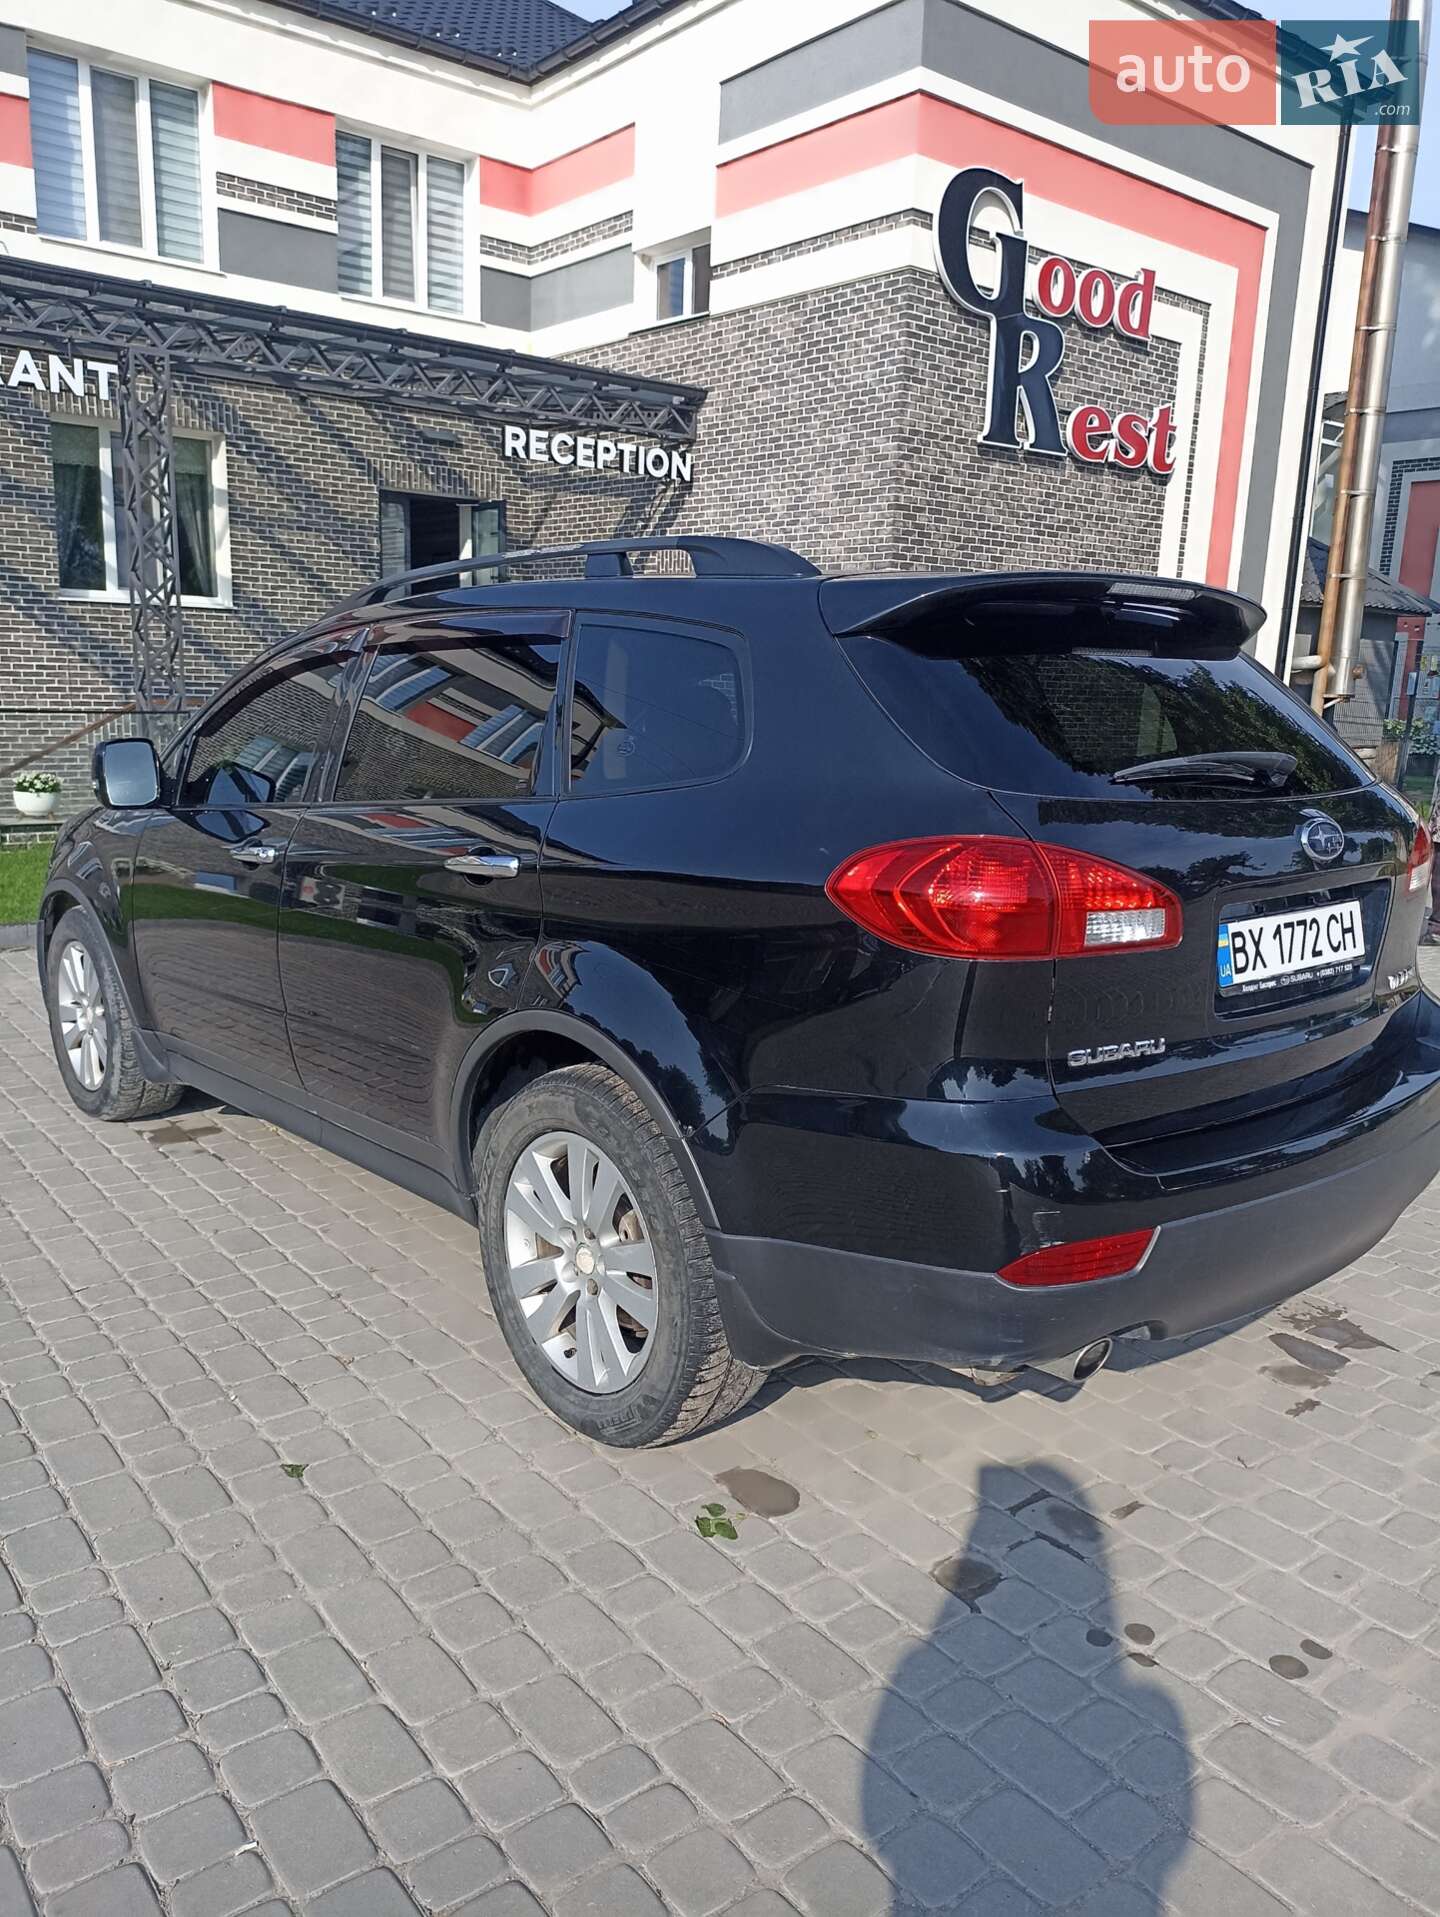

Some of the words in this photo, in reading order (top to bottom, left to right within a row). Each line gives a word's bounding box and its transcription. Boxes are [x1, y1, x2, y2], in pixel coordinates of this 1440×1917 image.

[934, 166, 1156, 341] Good
[0, 350, 119, 400] ANT
[978, 314, 1177, 475] Rest
[504, 425, 692, 482] RECEPTION
[1219, 963, 1232, 977] UA
[1231, 927, 1267, 975] BX
[1272, 917, 1323, 964] 1772
[1326, 910, 1357, 952] CH
[1067, 1038, 1166, 1067] SUBARU
